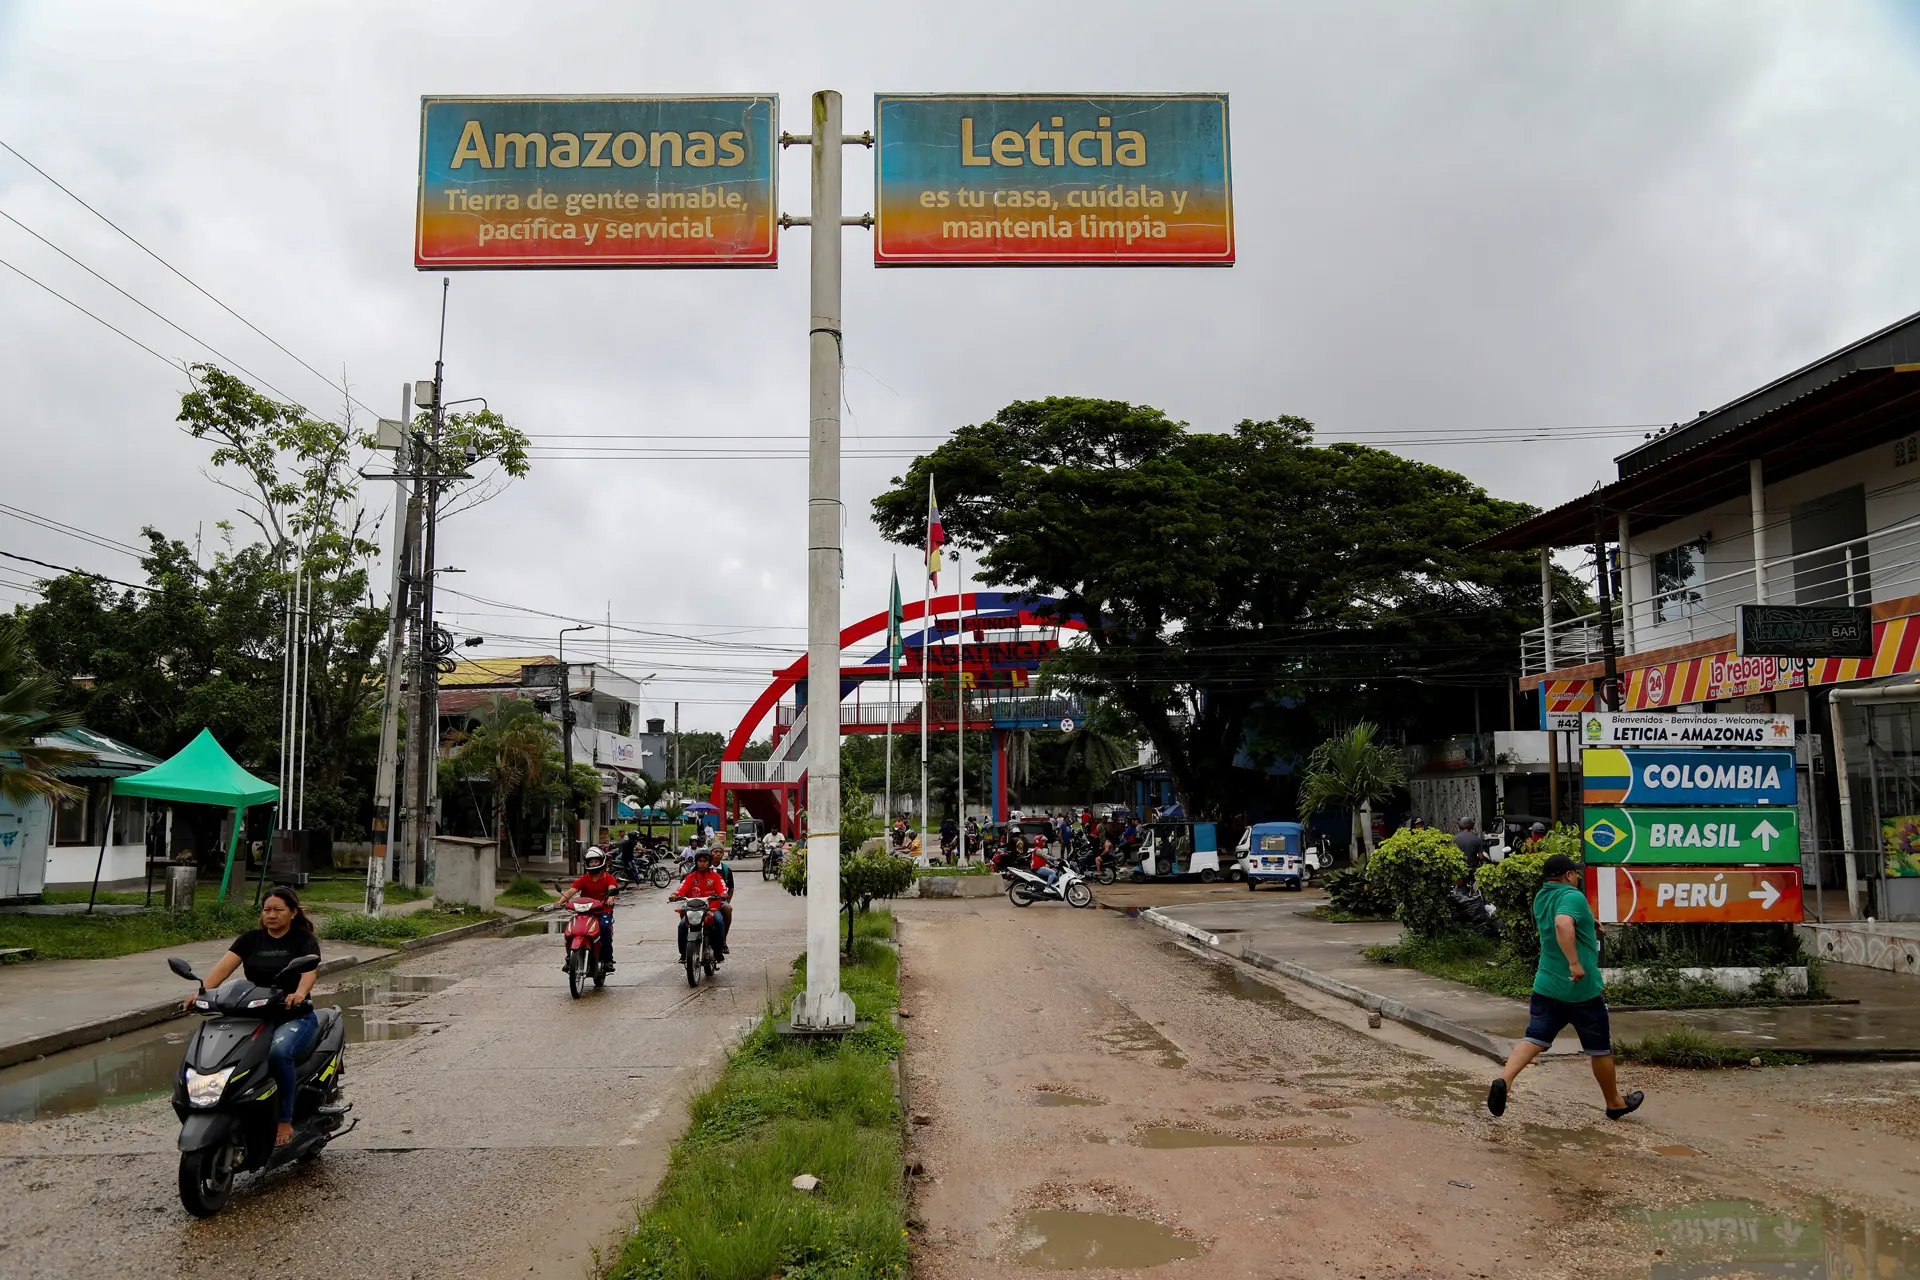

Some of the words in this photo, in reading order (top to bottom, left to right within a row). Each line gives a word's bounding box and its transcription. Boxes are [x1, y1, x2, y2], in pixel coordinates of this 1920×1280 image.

[450, 120, 745, 169] Amazonas
[961, 116, 1146, 166] Leticia
[444, 188, 520, 211] Tierra
[527, 188, 558, 210] de
[565, 189, 639, 216] gente
[646, 187, 748, 211] amable,
[920, 190, 949, 208] es
[957, 187, 985, 208] tu
[993, 190, 1059, 211] casa,
[1067, 185, 1164, 208] cuídala
[1172, 190, 1188, 215] y
[479, 217, 577, 246] pacífica
[584, 222, 599, 246] y
[605, 216, 714, 239] servicial
[943, 216, 1072, 239] mantenla
[1081, 215, 1167, 245] limpia
[1832, 627, 1857, 638] BAR
[947, 670, 1025, 689] BRASIL
[1649, 675, 1662, 692] 24
[1711, 661, 1723, 684] la
[1727, 656, 1775, 686] rebaja
[1767, 675, 1814, 687] DROGUERA
[1612, 715, 1663, 724] Bienvenidos
[1671, 716, 1718, 724] Bemvindos
[1725, 717, 1764, 725] Welcome
[1613, 727, 1668, 741] LETICIA
[1680, 728, 1764, 741] AMAZONAS
[1643, 764, 1781, 789] COLOMBIA
[1649, 823, 1741, 848] BRASIL
[1656, 872, 1728, 908] PERÚ
